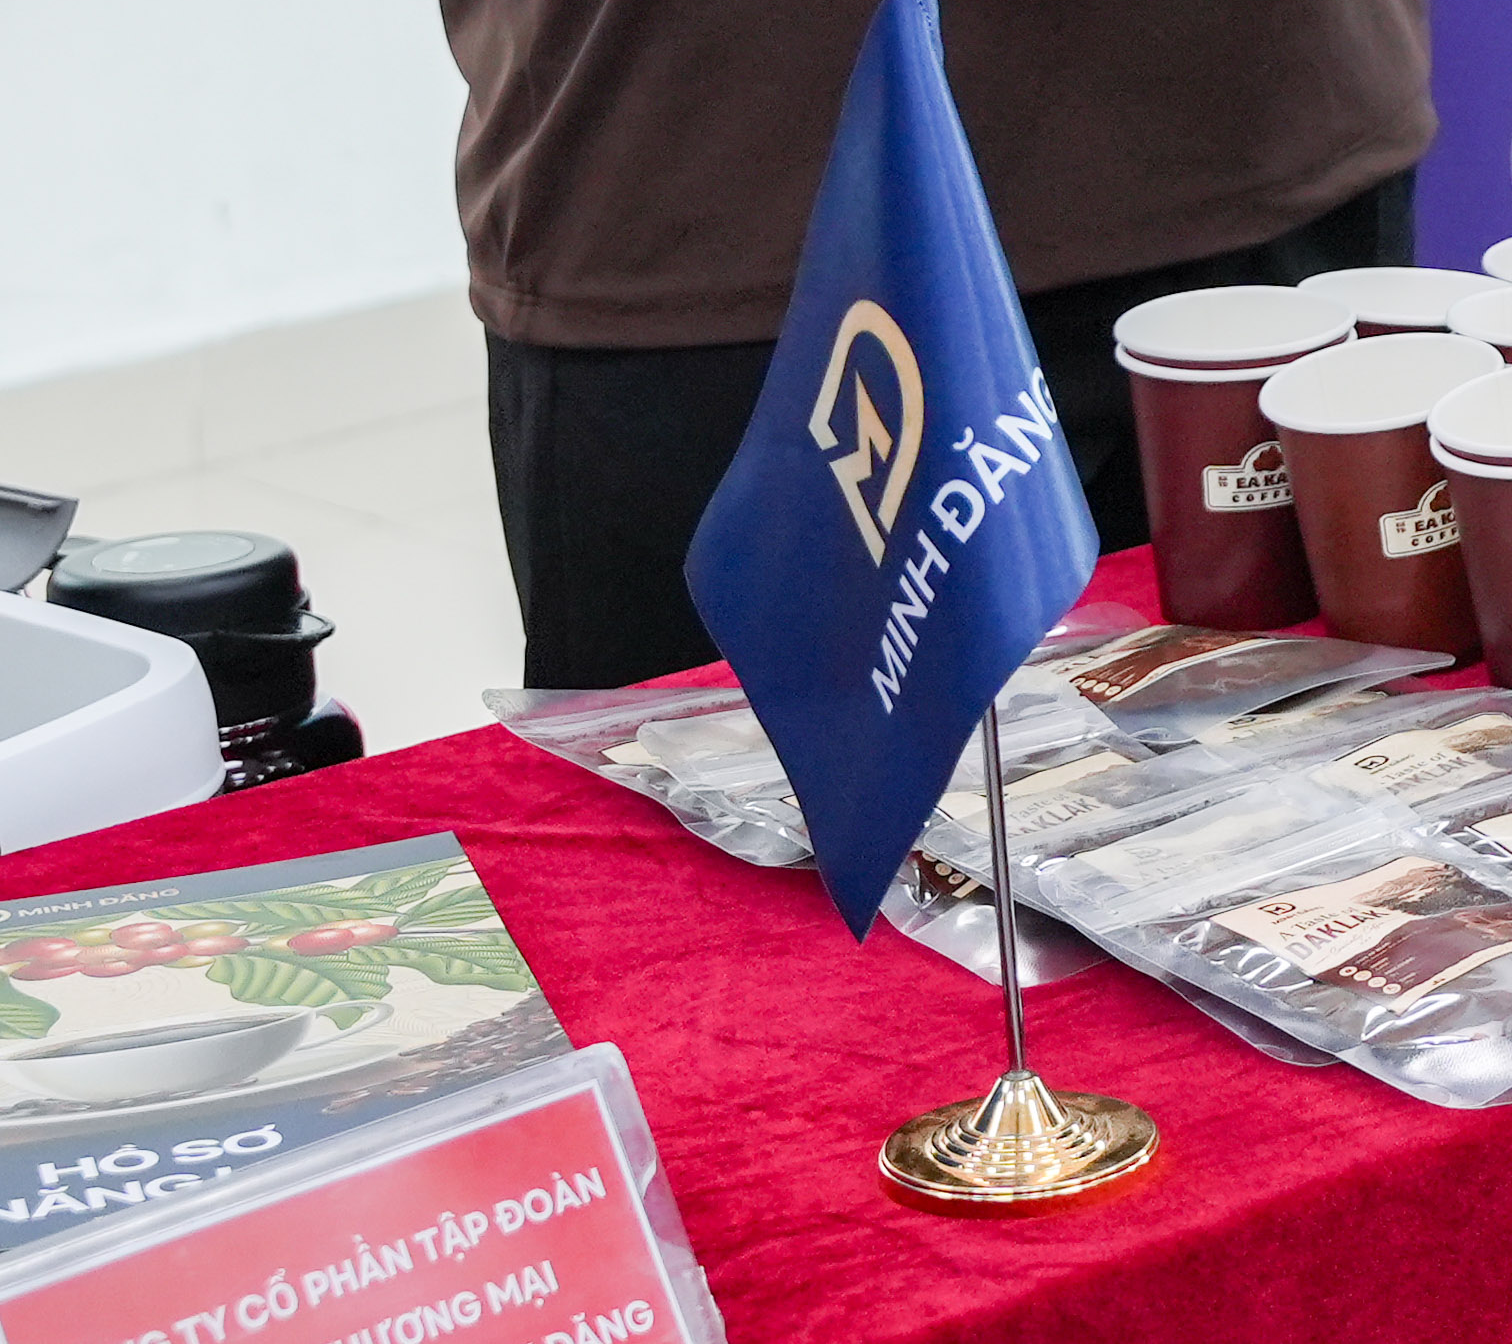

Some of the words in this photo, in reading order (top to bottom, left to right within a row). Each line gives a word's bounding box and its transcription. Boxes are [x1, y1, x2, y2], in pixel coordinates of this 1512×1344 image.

[1236, 474, 1260, 489] EA
[1264, 472, 1288, 487] KA
[1232, 489, 1291, 503] COFF
[1414, 516, 1438, 533] EA
[871, 529, 949, 714] MINH
[930, 366, 1059, 545] ĐĂNG
[1411, 526, 1460, 547] COFF
[18, 901, 92, 918] MINH
[1279, 931, 1296, 942] A
[1284, 910, 1391, 961] DAKLAK
[171, 1123, 283, 1163] SƠ
[171, 1305, 227, 1343] TY
[235, 1268, 299, 1330] CỔ
[302, 1234, 414, 1307] PHẦN
[415, 1210, 490, 1262] TẬP
[493, 1166, 608, 1235] ĐOÀN
[337, 1291, 483, 1344] HƯƠNG
[484, 1260, 559, 1314] MẠI
